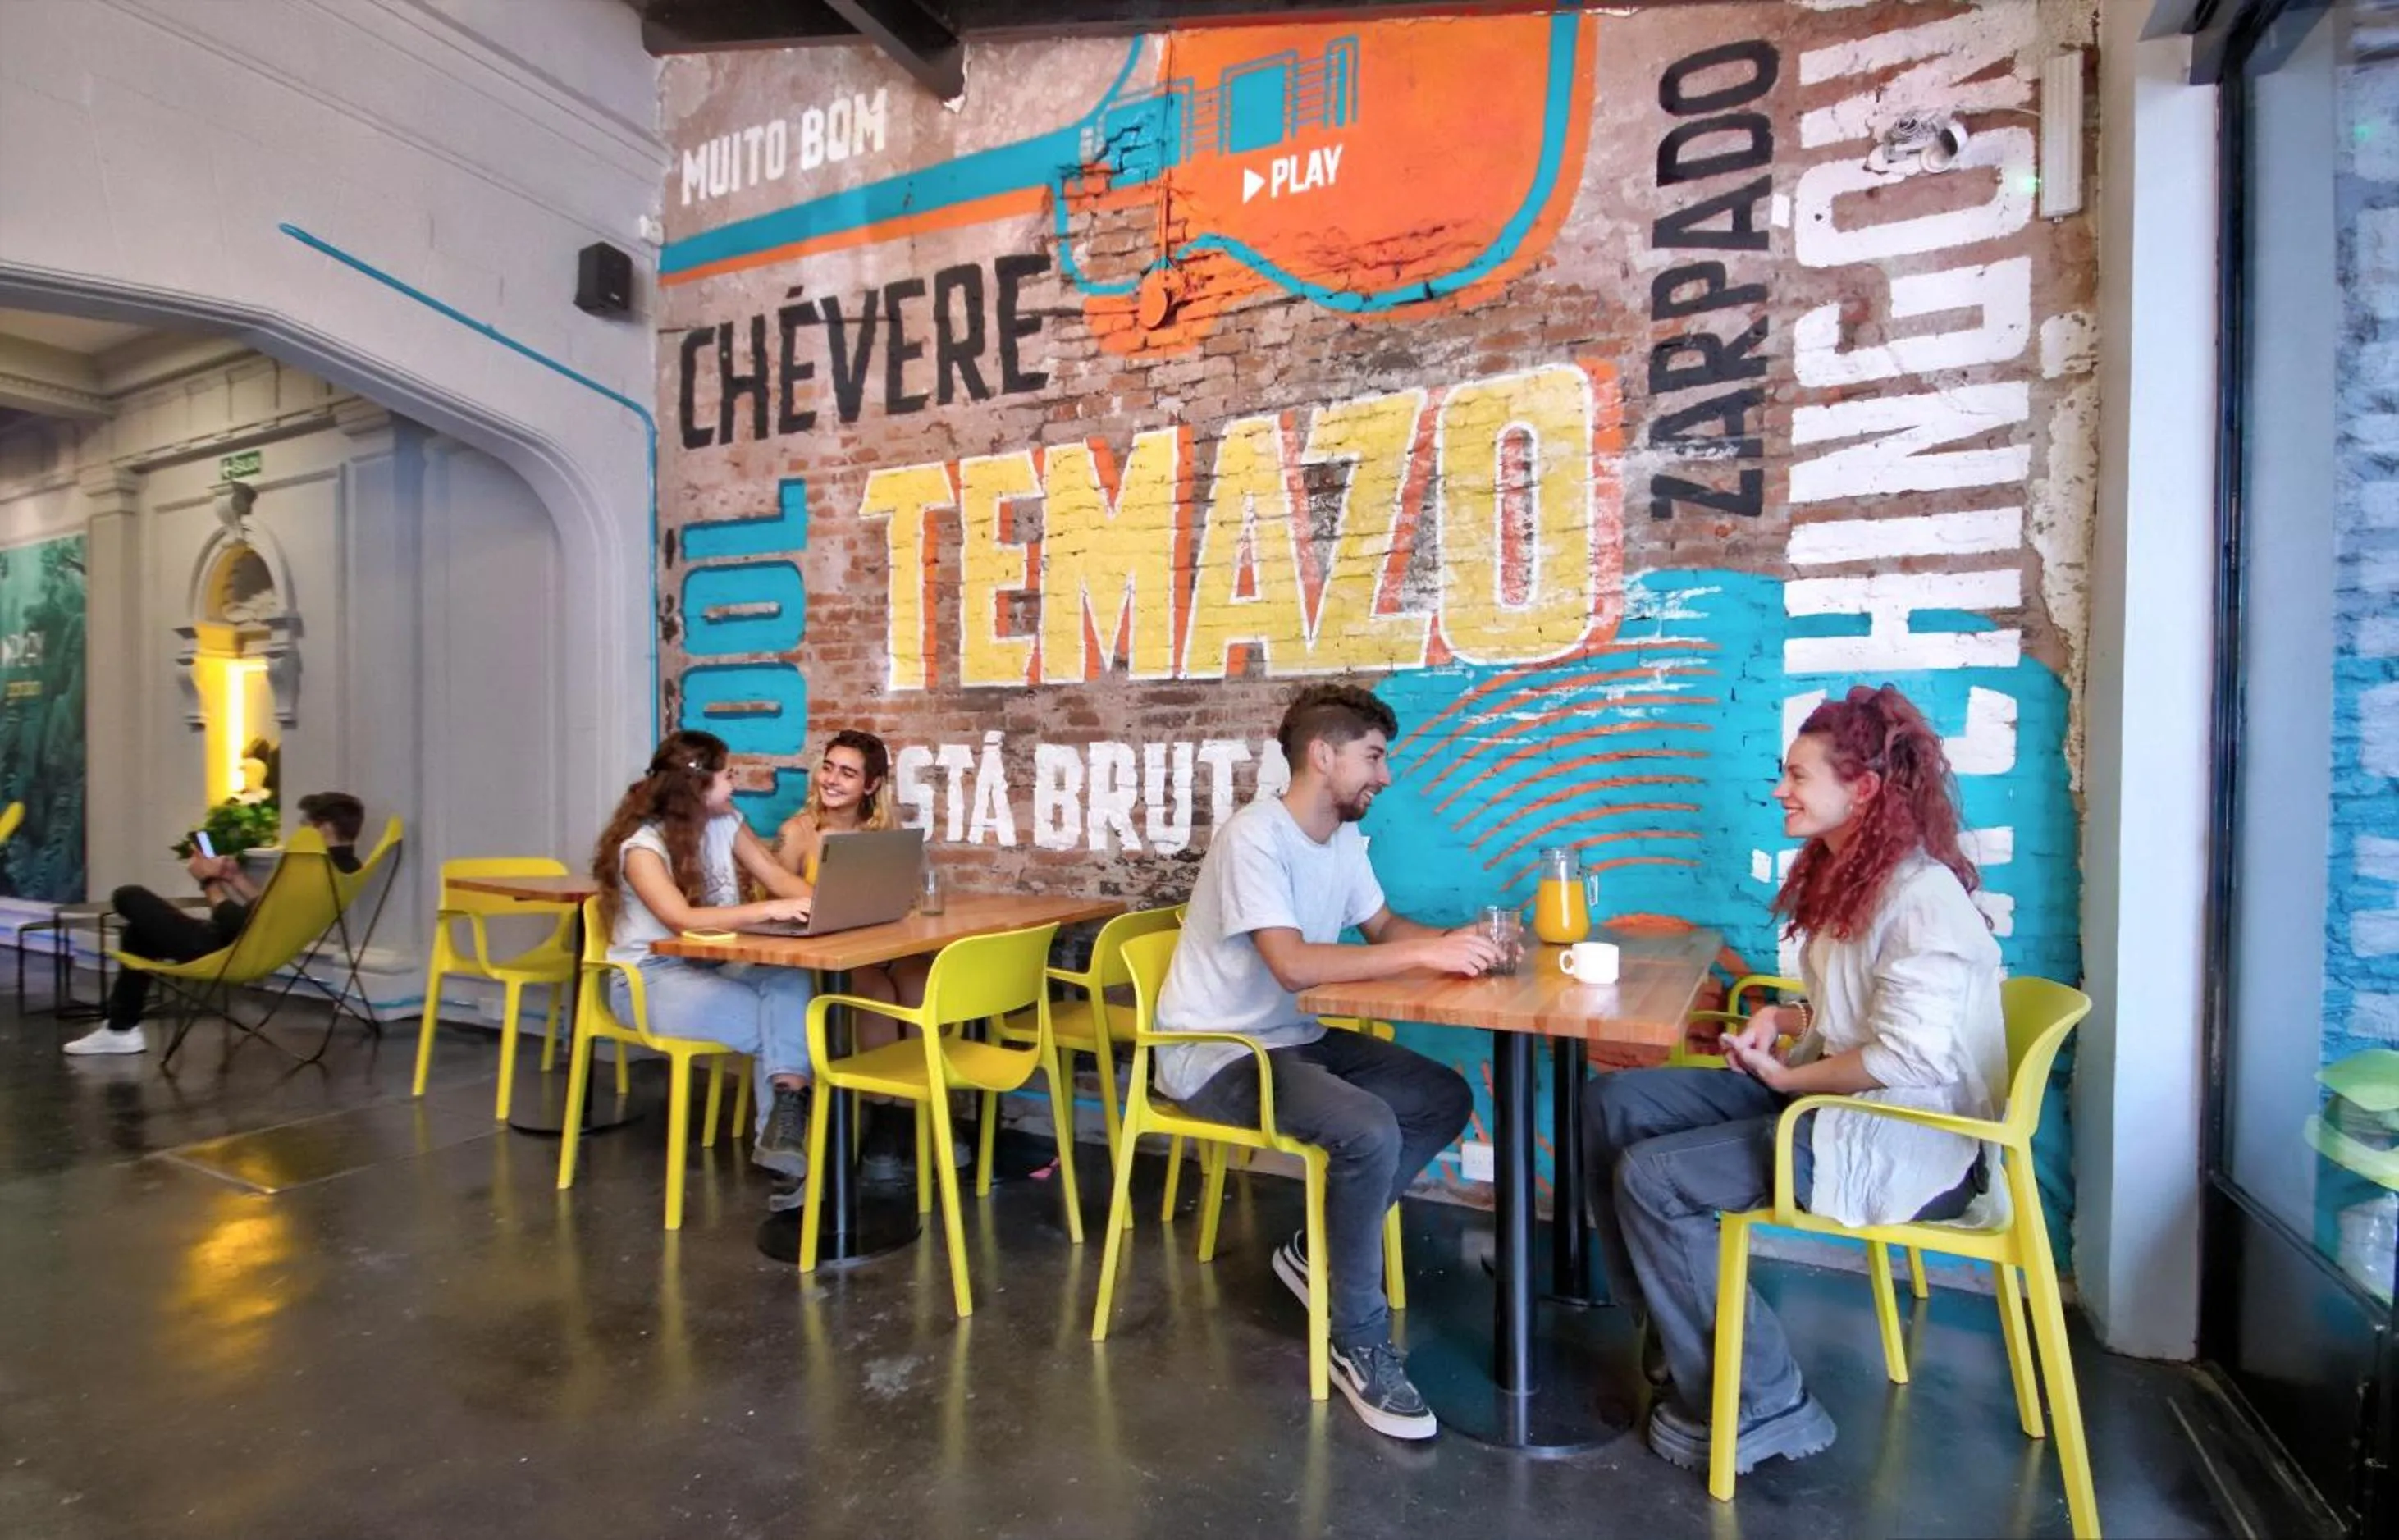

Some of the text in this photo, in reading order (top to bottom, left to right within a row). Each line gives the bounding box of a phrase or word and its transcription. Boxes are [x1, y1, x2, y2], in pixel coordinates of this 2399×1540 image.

[680, 88, 888, 205] MUITO BOM
[1270, 144, 1343, 199] PLAY
[679, 253, 1051, 449] CHÉVERE
[1648, 39, 1780, 520] ZARPADO
[859, 361, 1598, 692] TEMAZO
[885, 729, 1017, 848] STÁ
